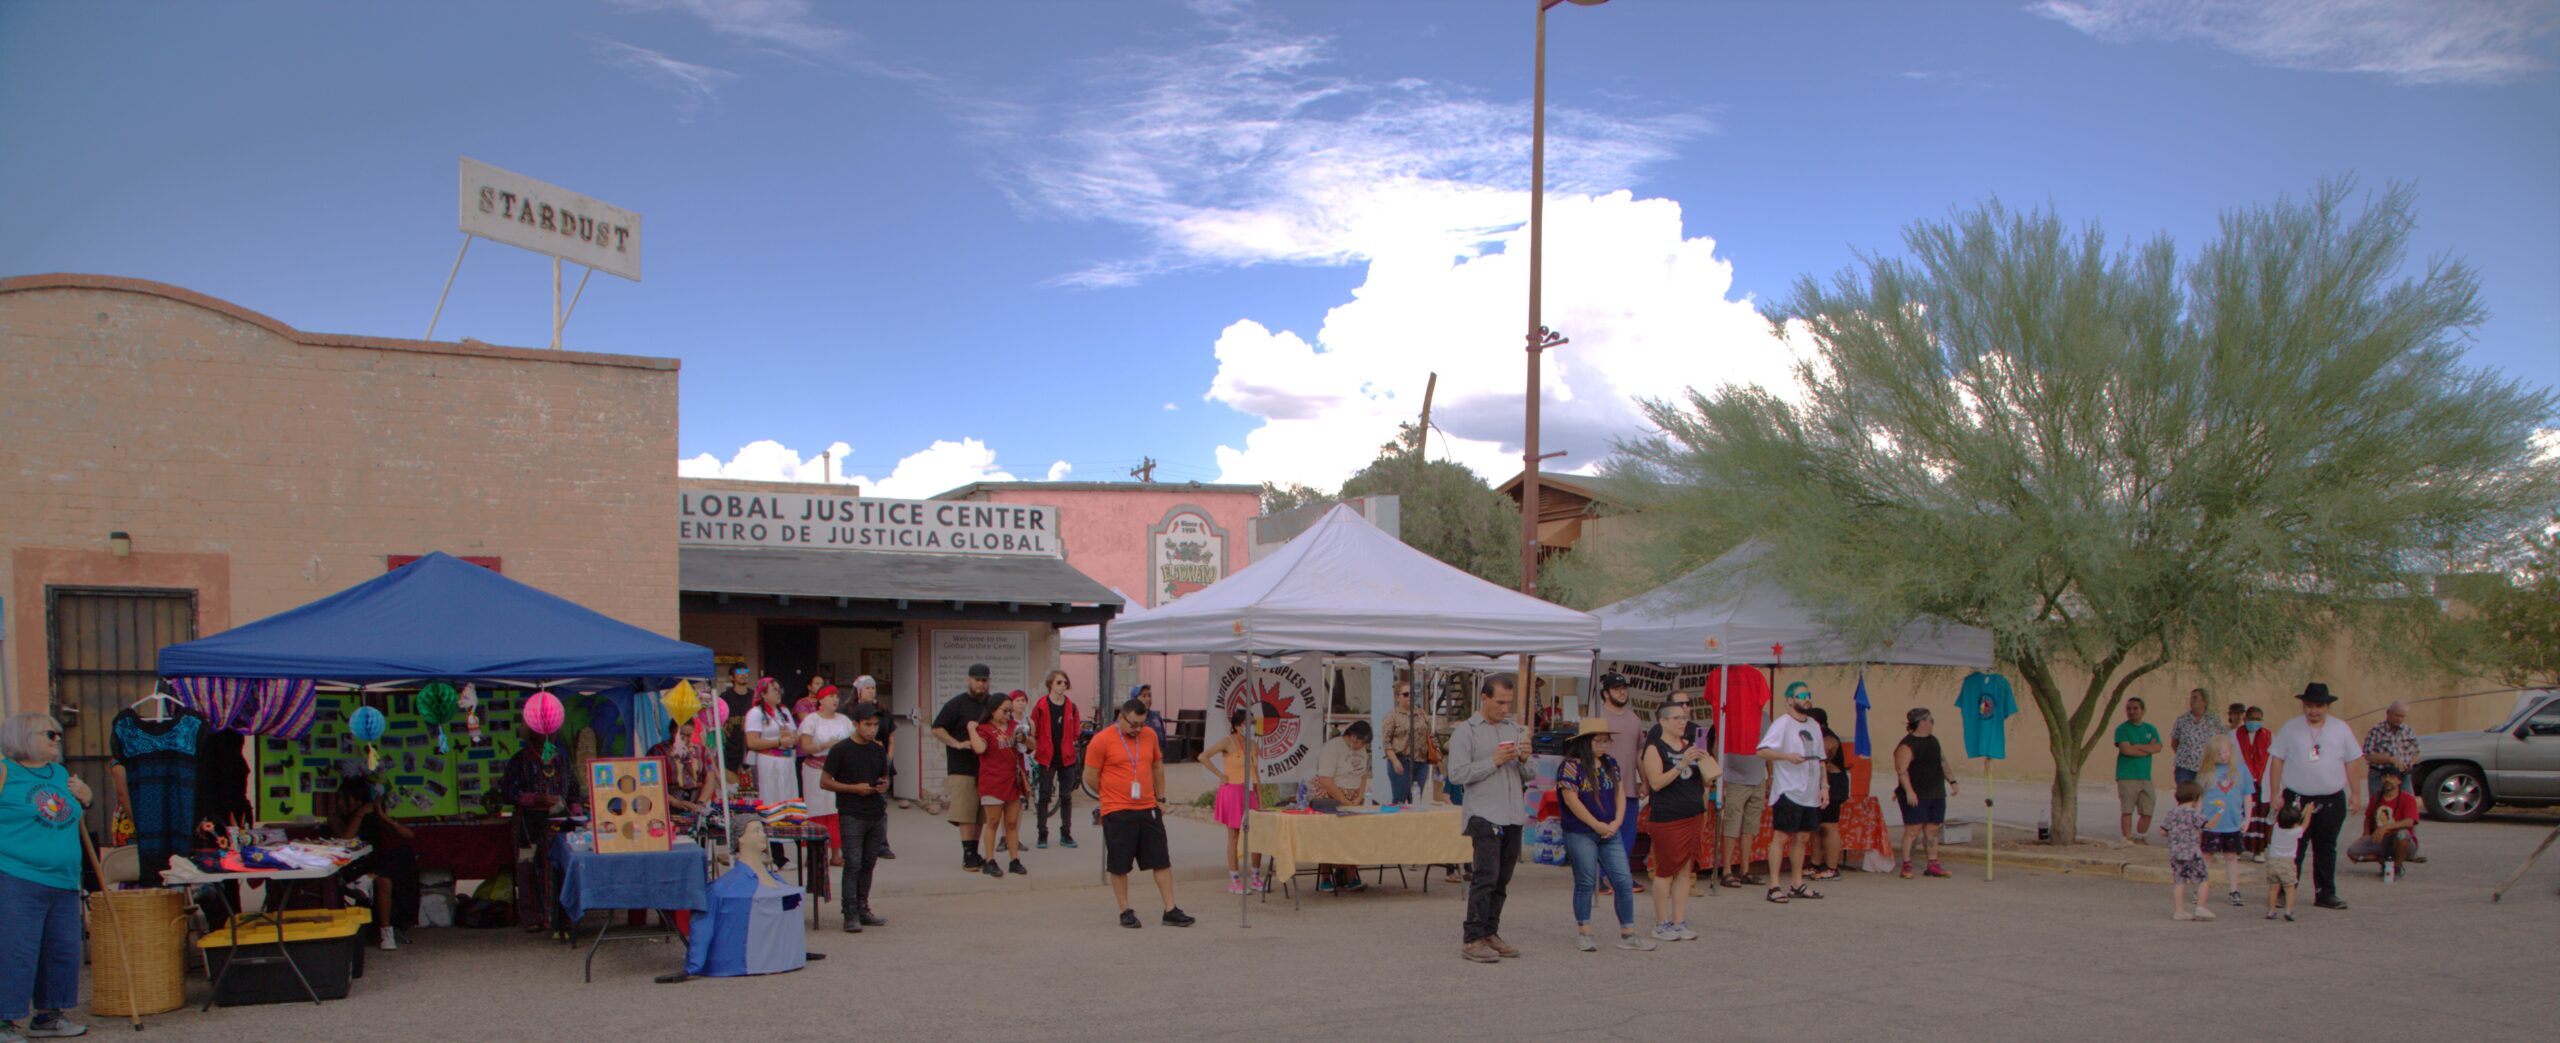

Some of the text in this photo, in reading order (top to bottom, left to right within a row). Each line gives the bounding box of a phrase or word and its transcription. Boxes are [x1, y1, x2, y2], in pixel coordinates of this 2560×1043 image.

[478, 185, 630, 253] STARDUST
[681, 493, 1045, 530] LOBAL JUSTICE CENTER
[680, 521, 1045, 551] ENTRO DE JUSTICIA GLOBAL
[943, 641, 1017, 650] Global Justice Center
[952, 634, 985, 642] Welcome
[1299, 686, 1317, 710] DAY
[1267, 743, 1309, 777] ARIZONA
